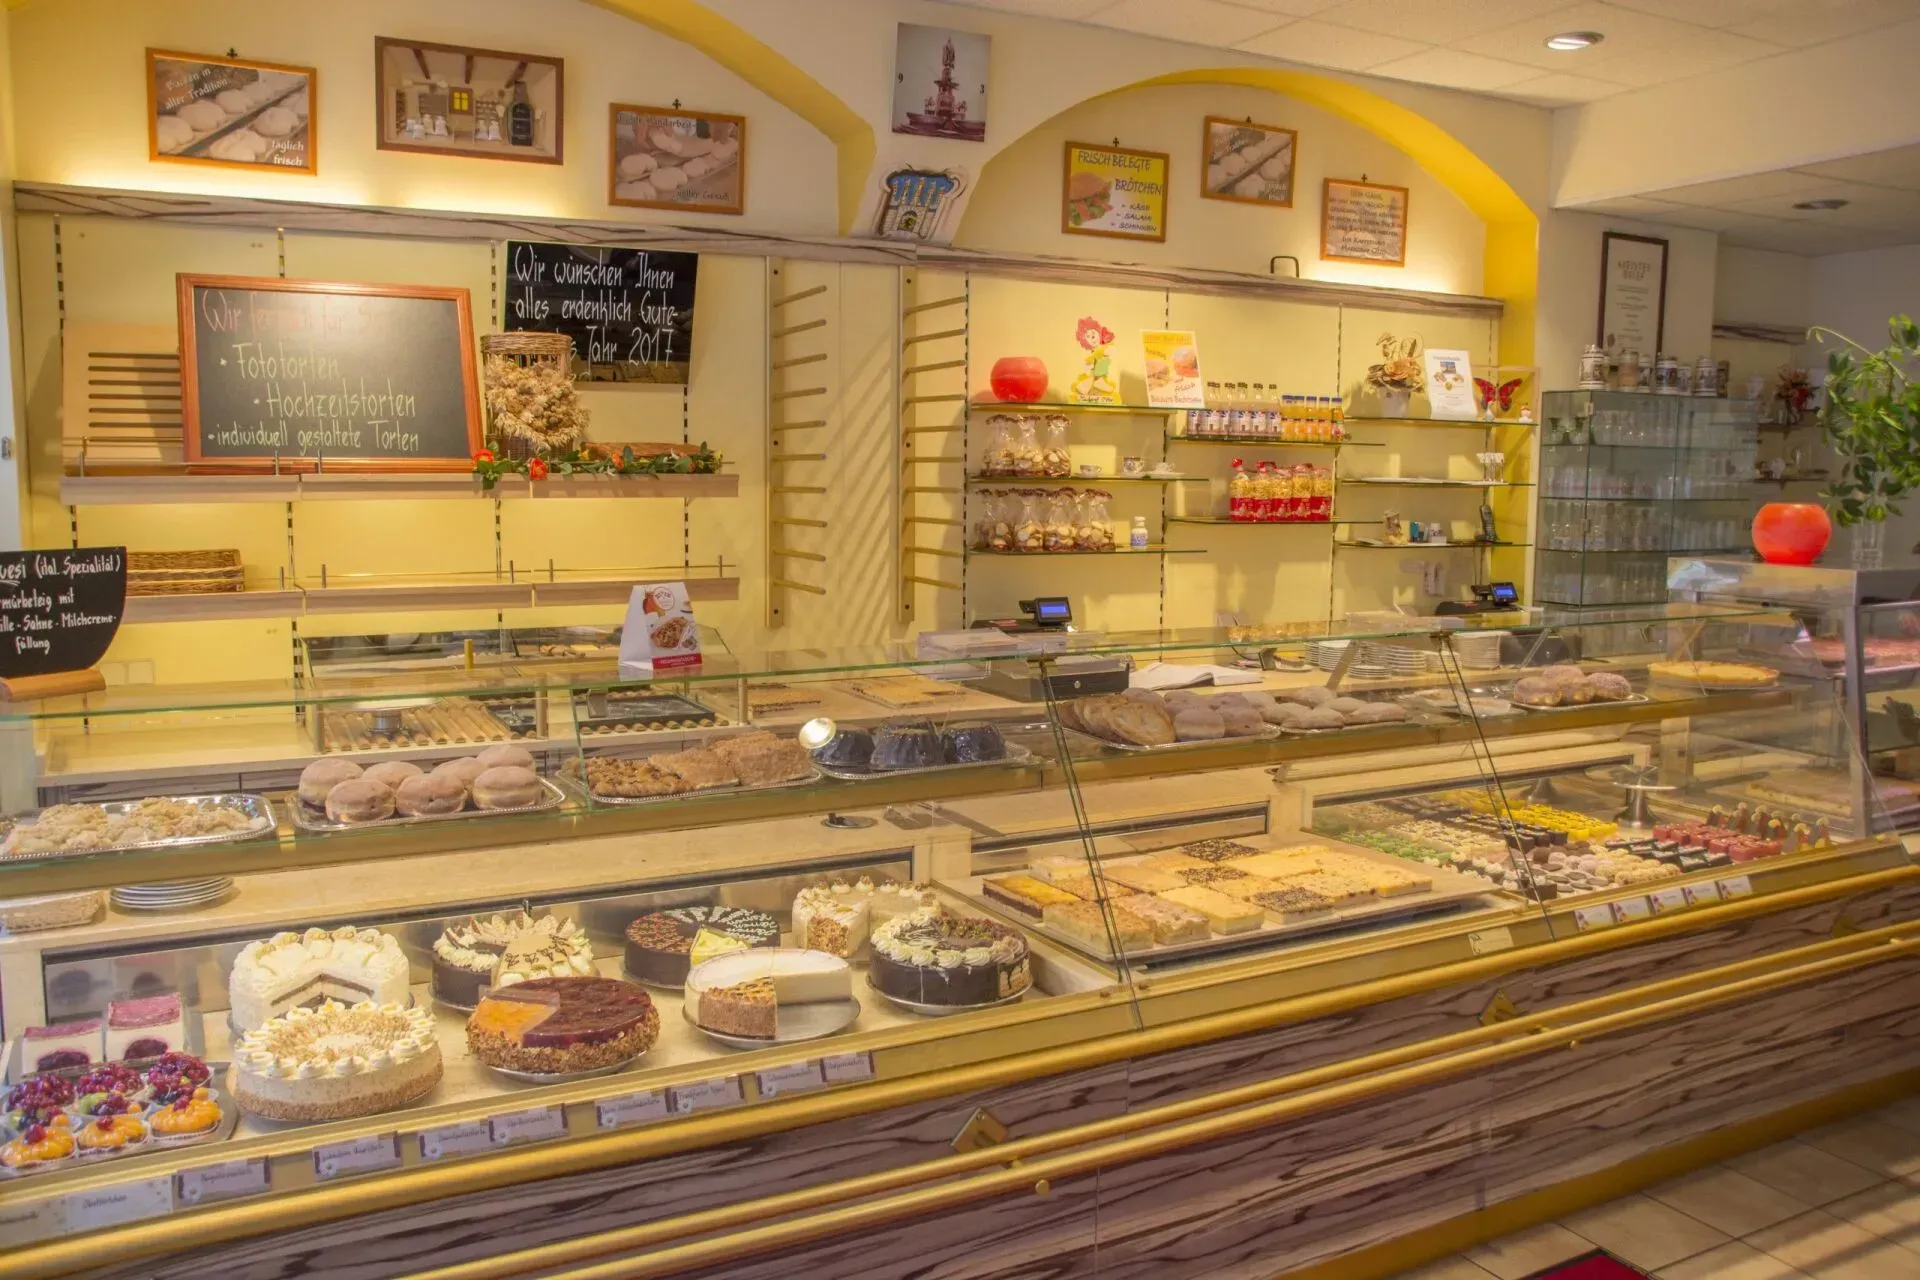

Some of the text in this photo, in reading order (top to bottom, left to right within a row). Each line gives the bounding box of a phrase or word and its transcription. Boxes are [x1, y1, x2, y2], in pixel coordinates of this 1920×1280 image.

[188, 77, 228, 100] Tradition
[271, 139, 305, 153] täglich
[273, 155, 303, 167] frisch
[1078, 150, 1151, 172] FRISCH BELEGTE
[1119, 222, 1157, 232] SCHINKEN
[1124, 211, 1153, 221] SALAMI
[514, 243, 675, 290] Wir wünschen Ihnen
[202, 288, 242, 333] Wir
[515, 286, 550, 320] alles
[561, 288, 632, 326] erdenklich
[231, 341, 340, 380] Fototorten
[580, 325, 618, 376] Jahr
[628, 326, 675, 368] 2017
[265, 376, 416, 418] Hochzeitstorten
[216, 418, 420, 457] individuell gestaltete Torten
[0, 557, 27, 580] vesi
[62, 553, 121, 580] Spezialität)
[58, 586, 75, 604] mit
[23, 613, 53, 632] Sahne
